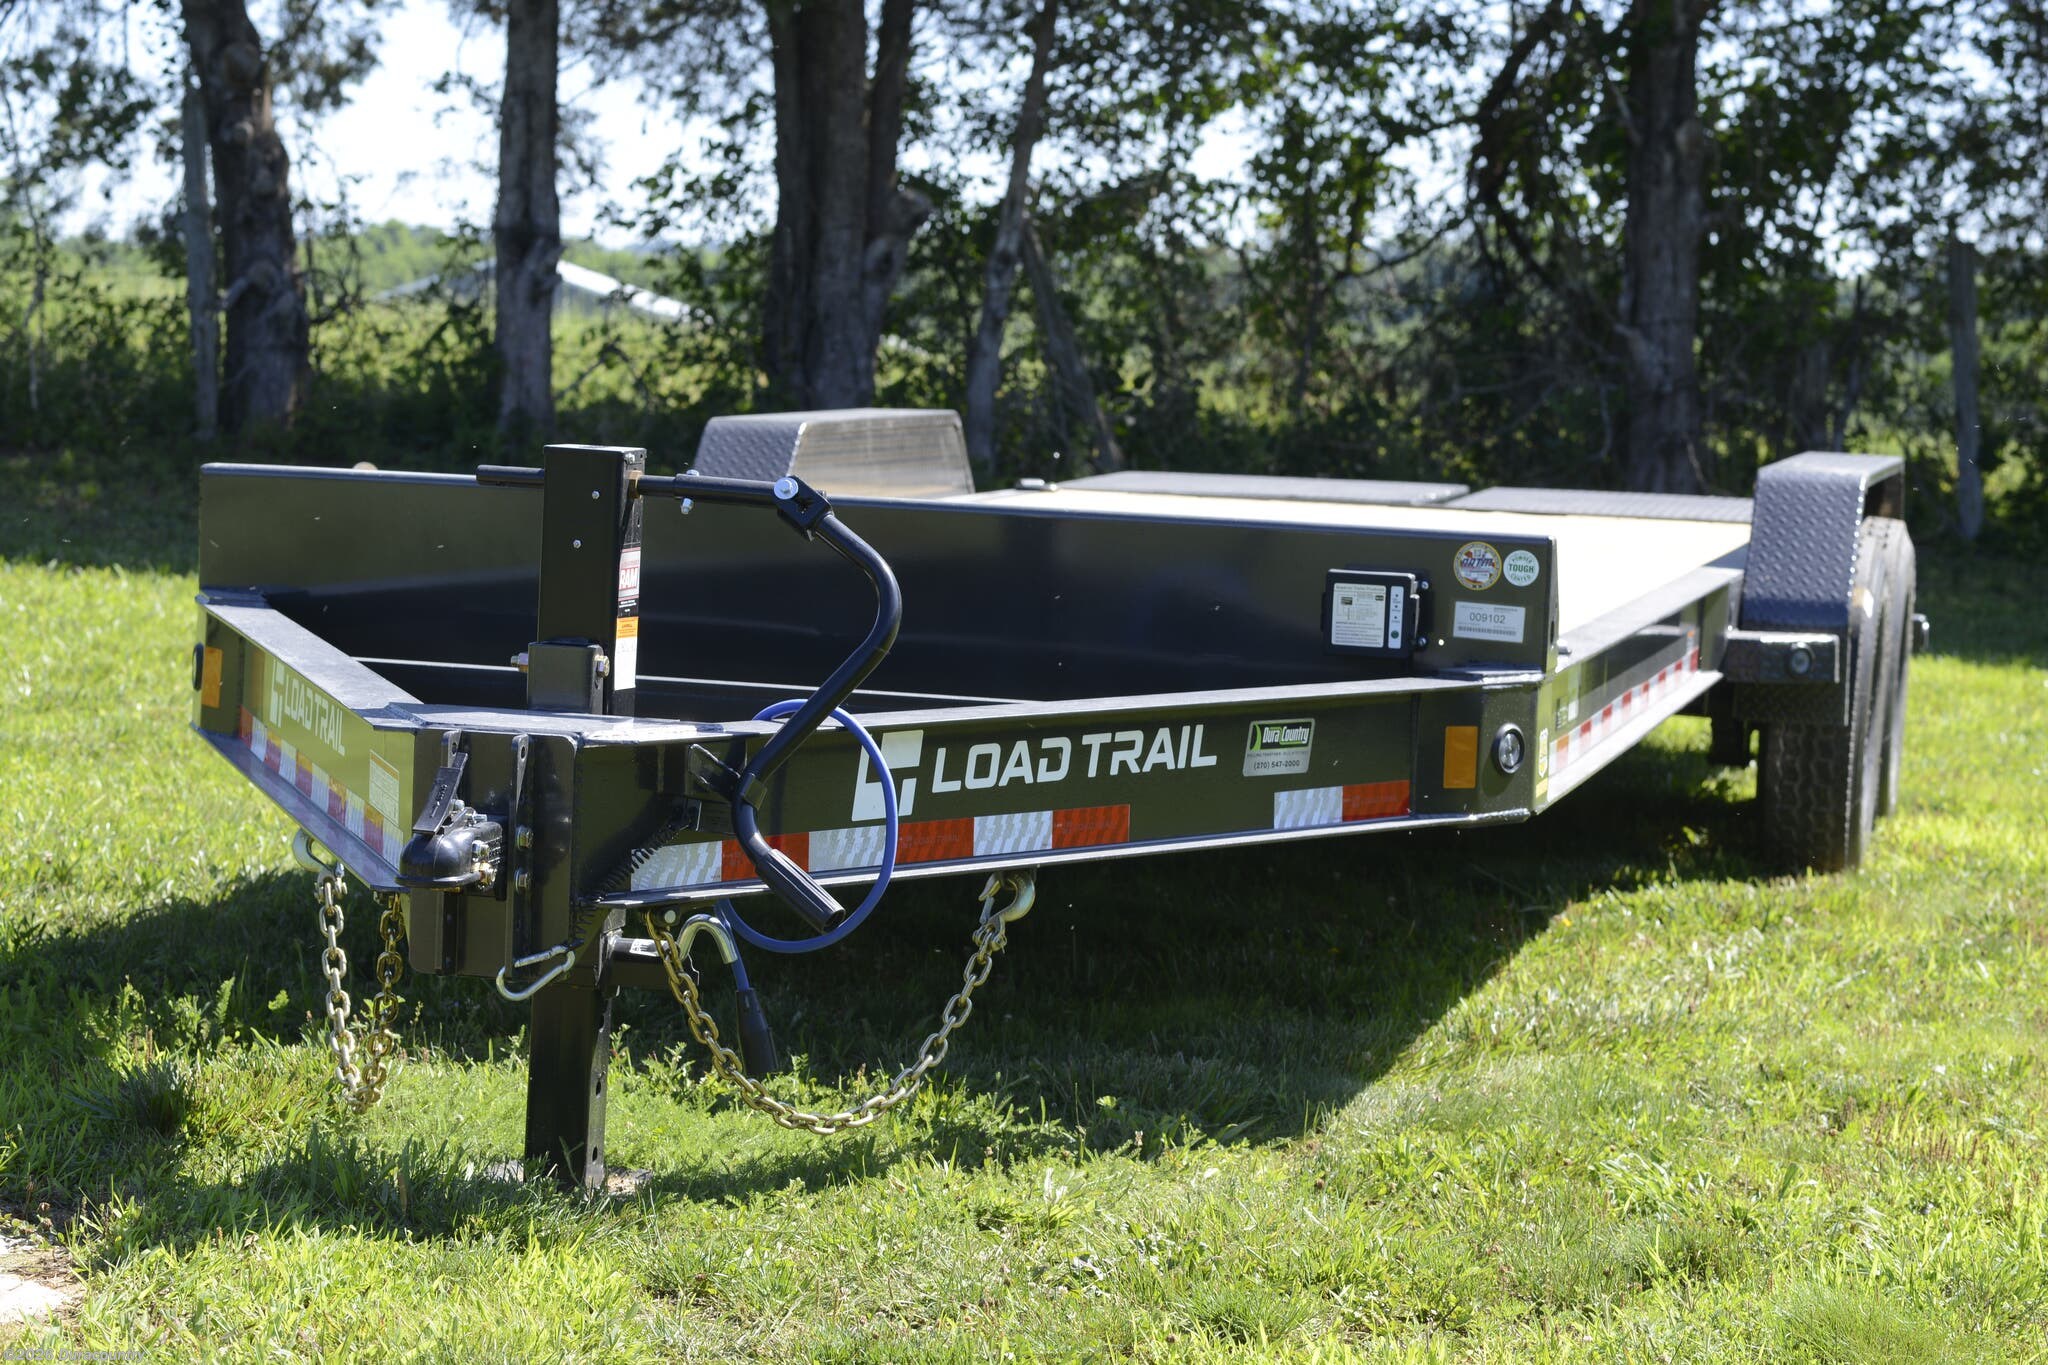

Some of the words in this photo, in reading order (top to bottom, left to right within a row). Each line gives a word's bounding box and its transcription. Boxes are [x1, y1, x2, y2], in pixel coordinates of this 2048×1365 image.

[1508, 563, 1534, 573] TOUGH
[619, 568, 637, 589] RAM
[1469, 612, 1506, 624] 009102
[284, 673, 313, 731] LOAD
[314, 692, 346, 757] TRAIL
[1262, 727, 1280, 743] Dura
[1281, 727, 1309, 744] Country
[932, 736, 1072, 794] LOAD
[1081, 724, 1217, 778] TRAIL
[1254, 761, 1270, 770] (270)
[1271, 760, 1300, 768] 547-2000
